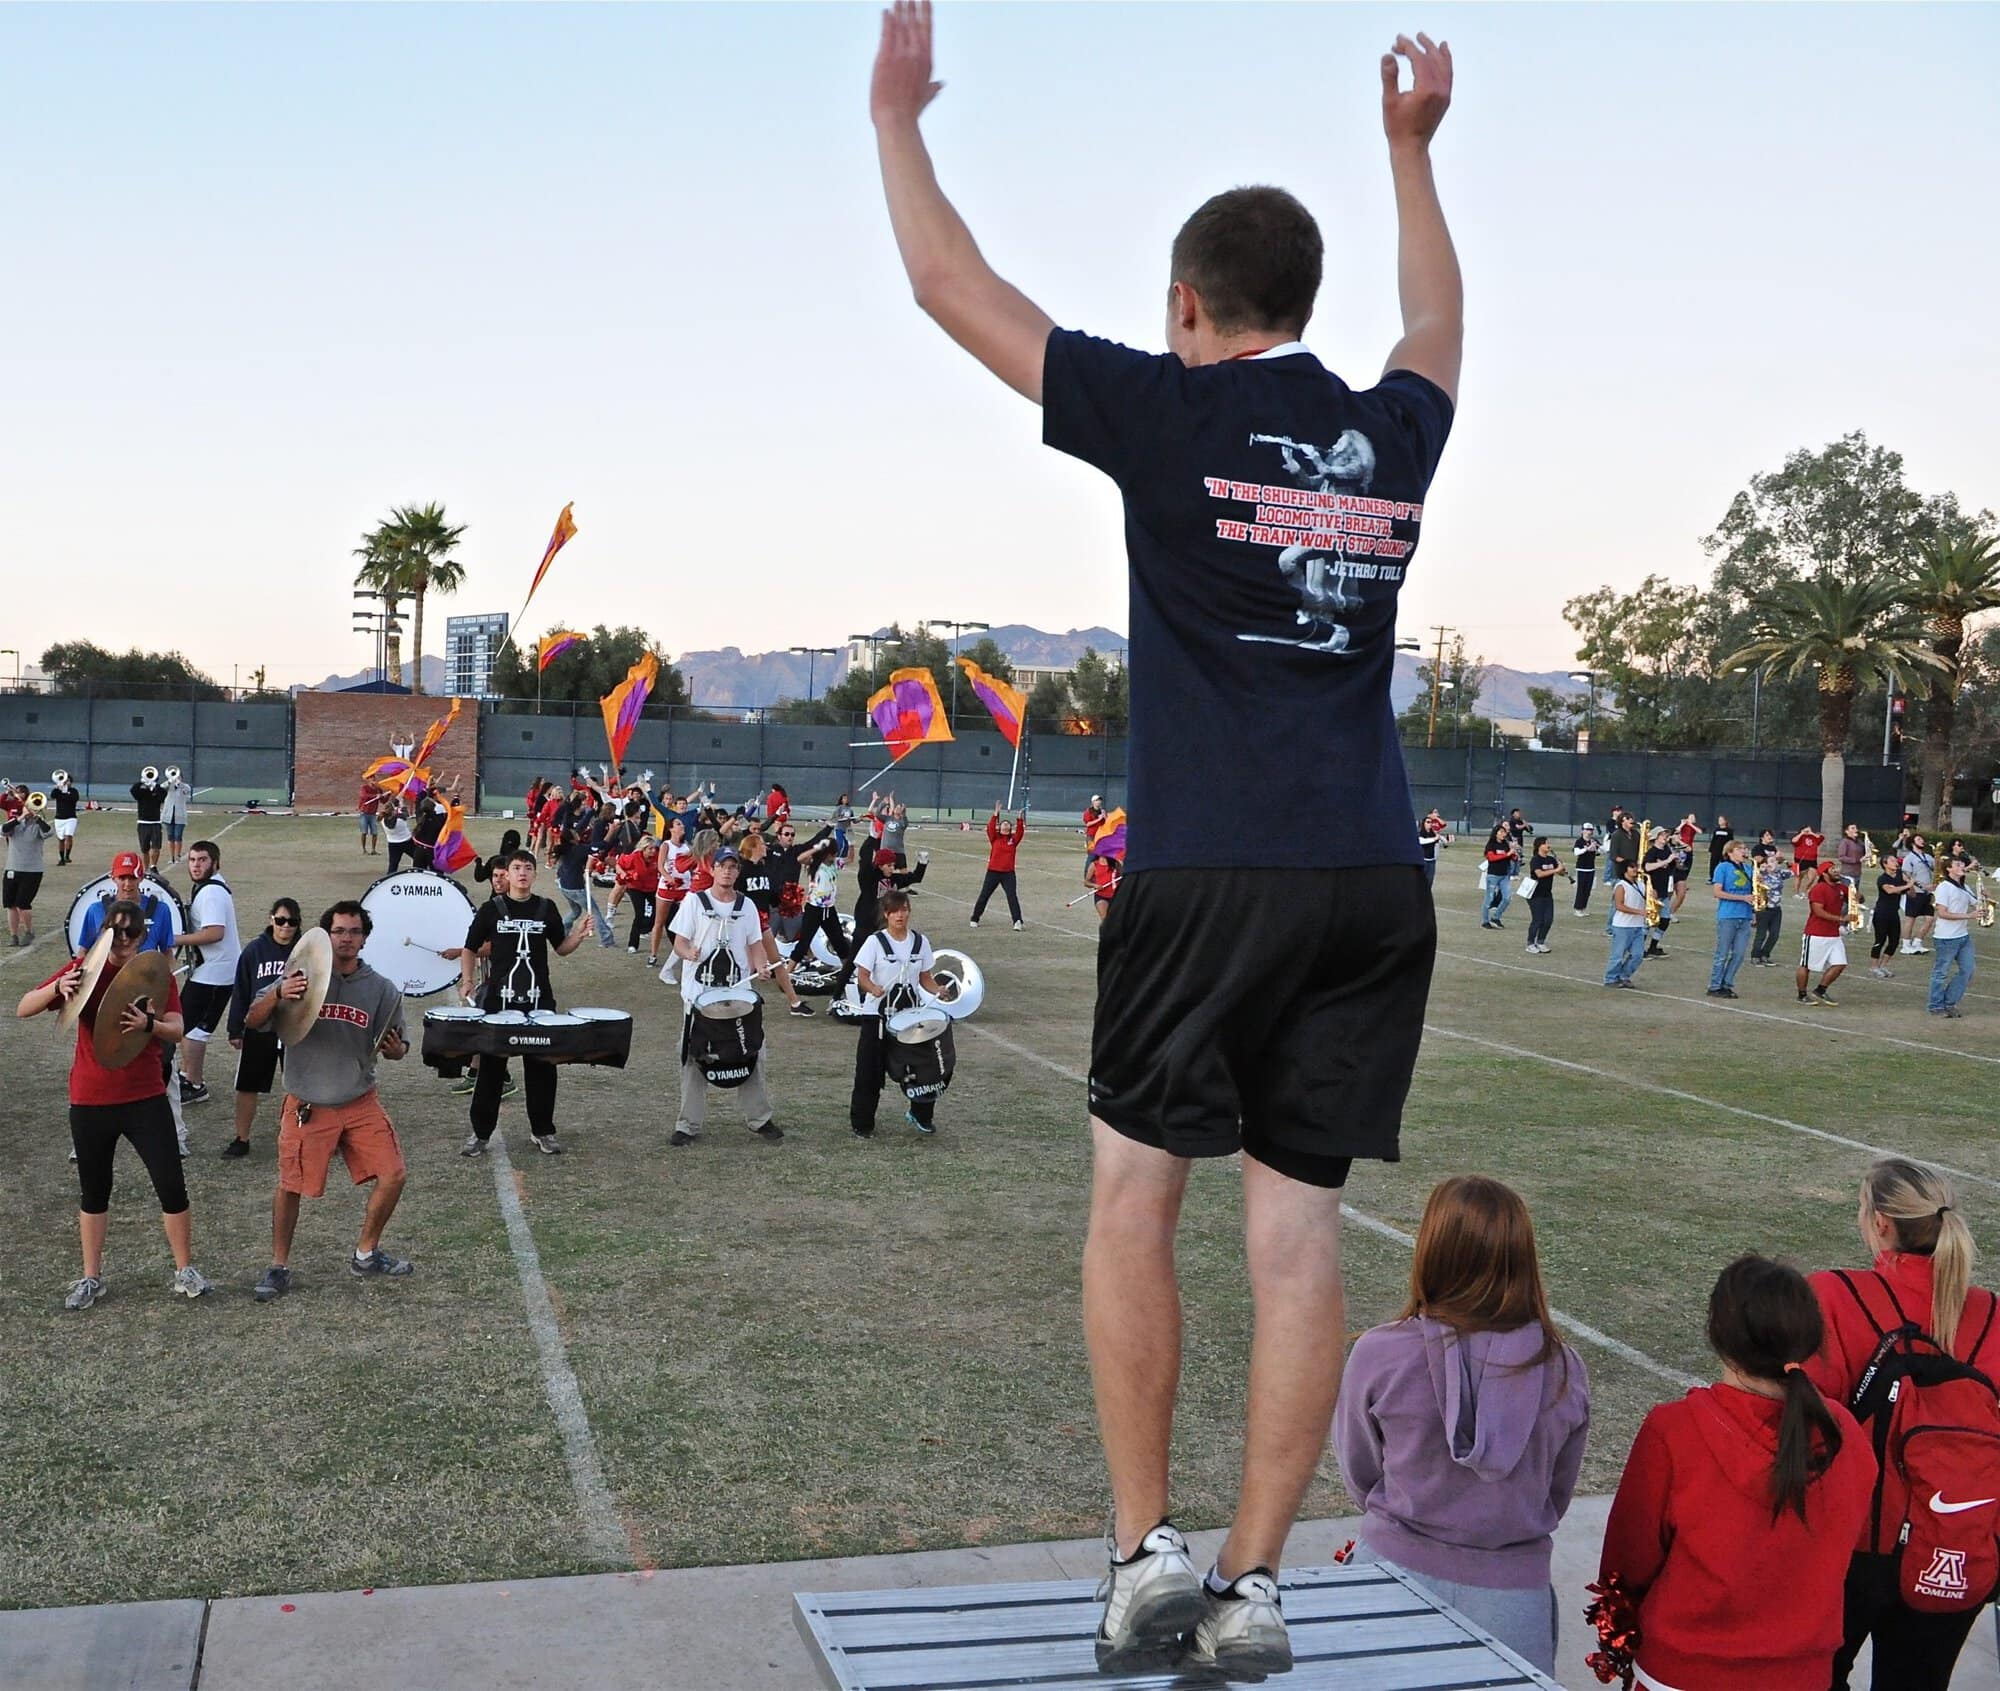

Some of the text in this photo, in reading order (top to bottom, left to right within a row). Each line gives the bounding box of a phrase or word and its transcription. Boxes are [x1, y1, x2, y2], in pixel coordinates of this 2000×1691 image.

[1231, 481, 1260, 502] THE
[1262, 486, 1335, 510] SHUFFLING
[1337, 494, 1394, 518] MADNESS
[1395, 502, 1410, 519] OF
[1256, 504, 1342, 532] LOCOMOTIVE
[1216, 519, 1247, 541] THE
[1249, 524, 1297, 546] TRAIN
[1299, 531, 1345, 552] WON'T
[1346, 535, 1376, 554] STOP
[1379, 565, 1401, 580] TULL
[403, 885, 442, 897] YAMAHA
[256, 960, 287, 979] ARIZ
[519, 1036, 551, 1046] YAMAHA
[716, 1066, 750, 1080] YAMAHA
[1918, 1547, 1966, 1590] A
[1914, 1583, 1965, 1599] POMLINE
